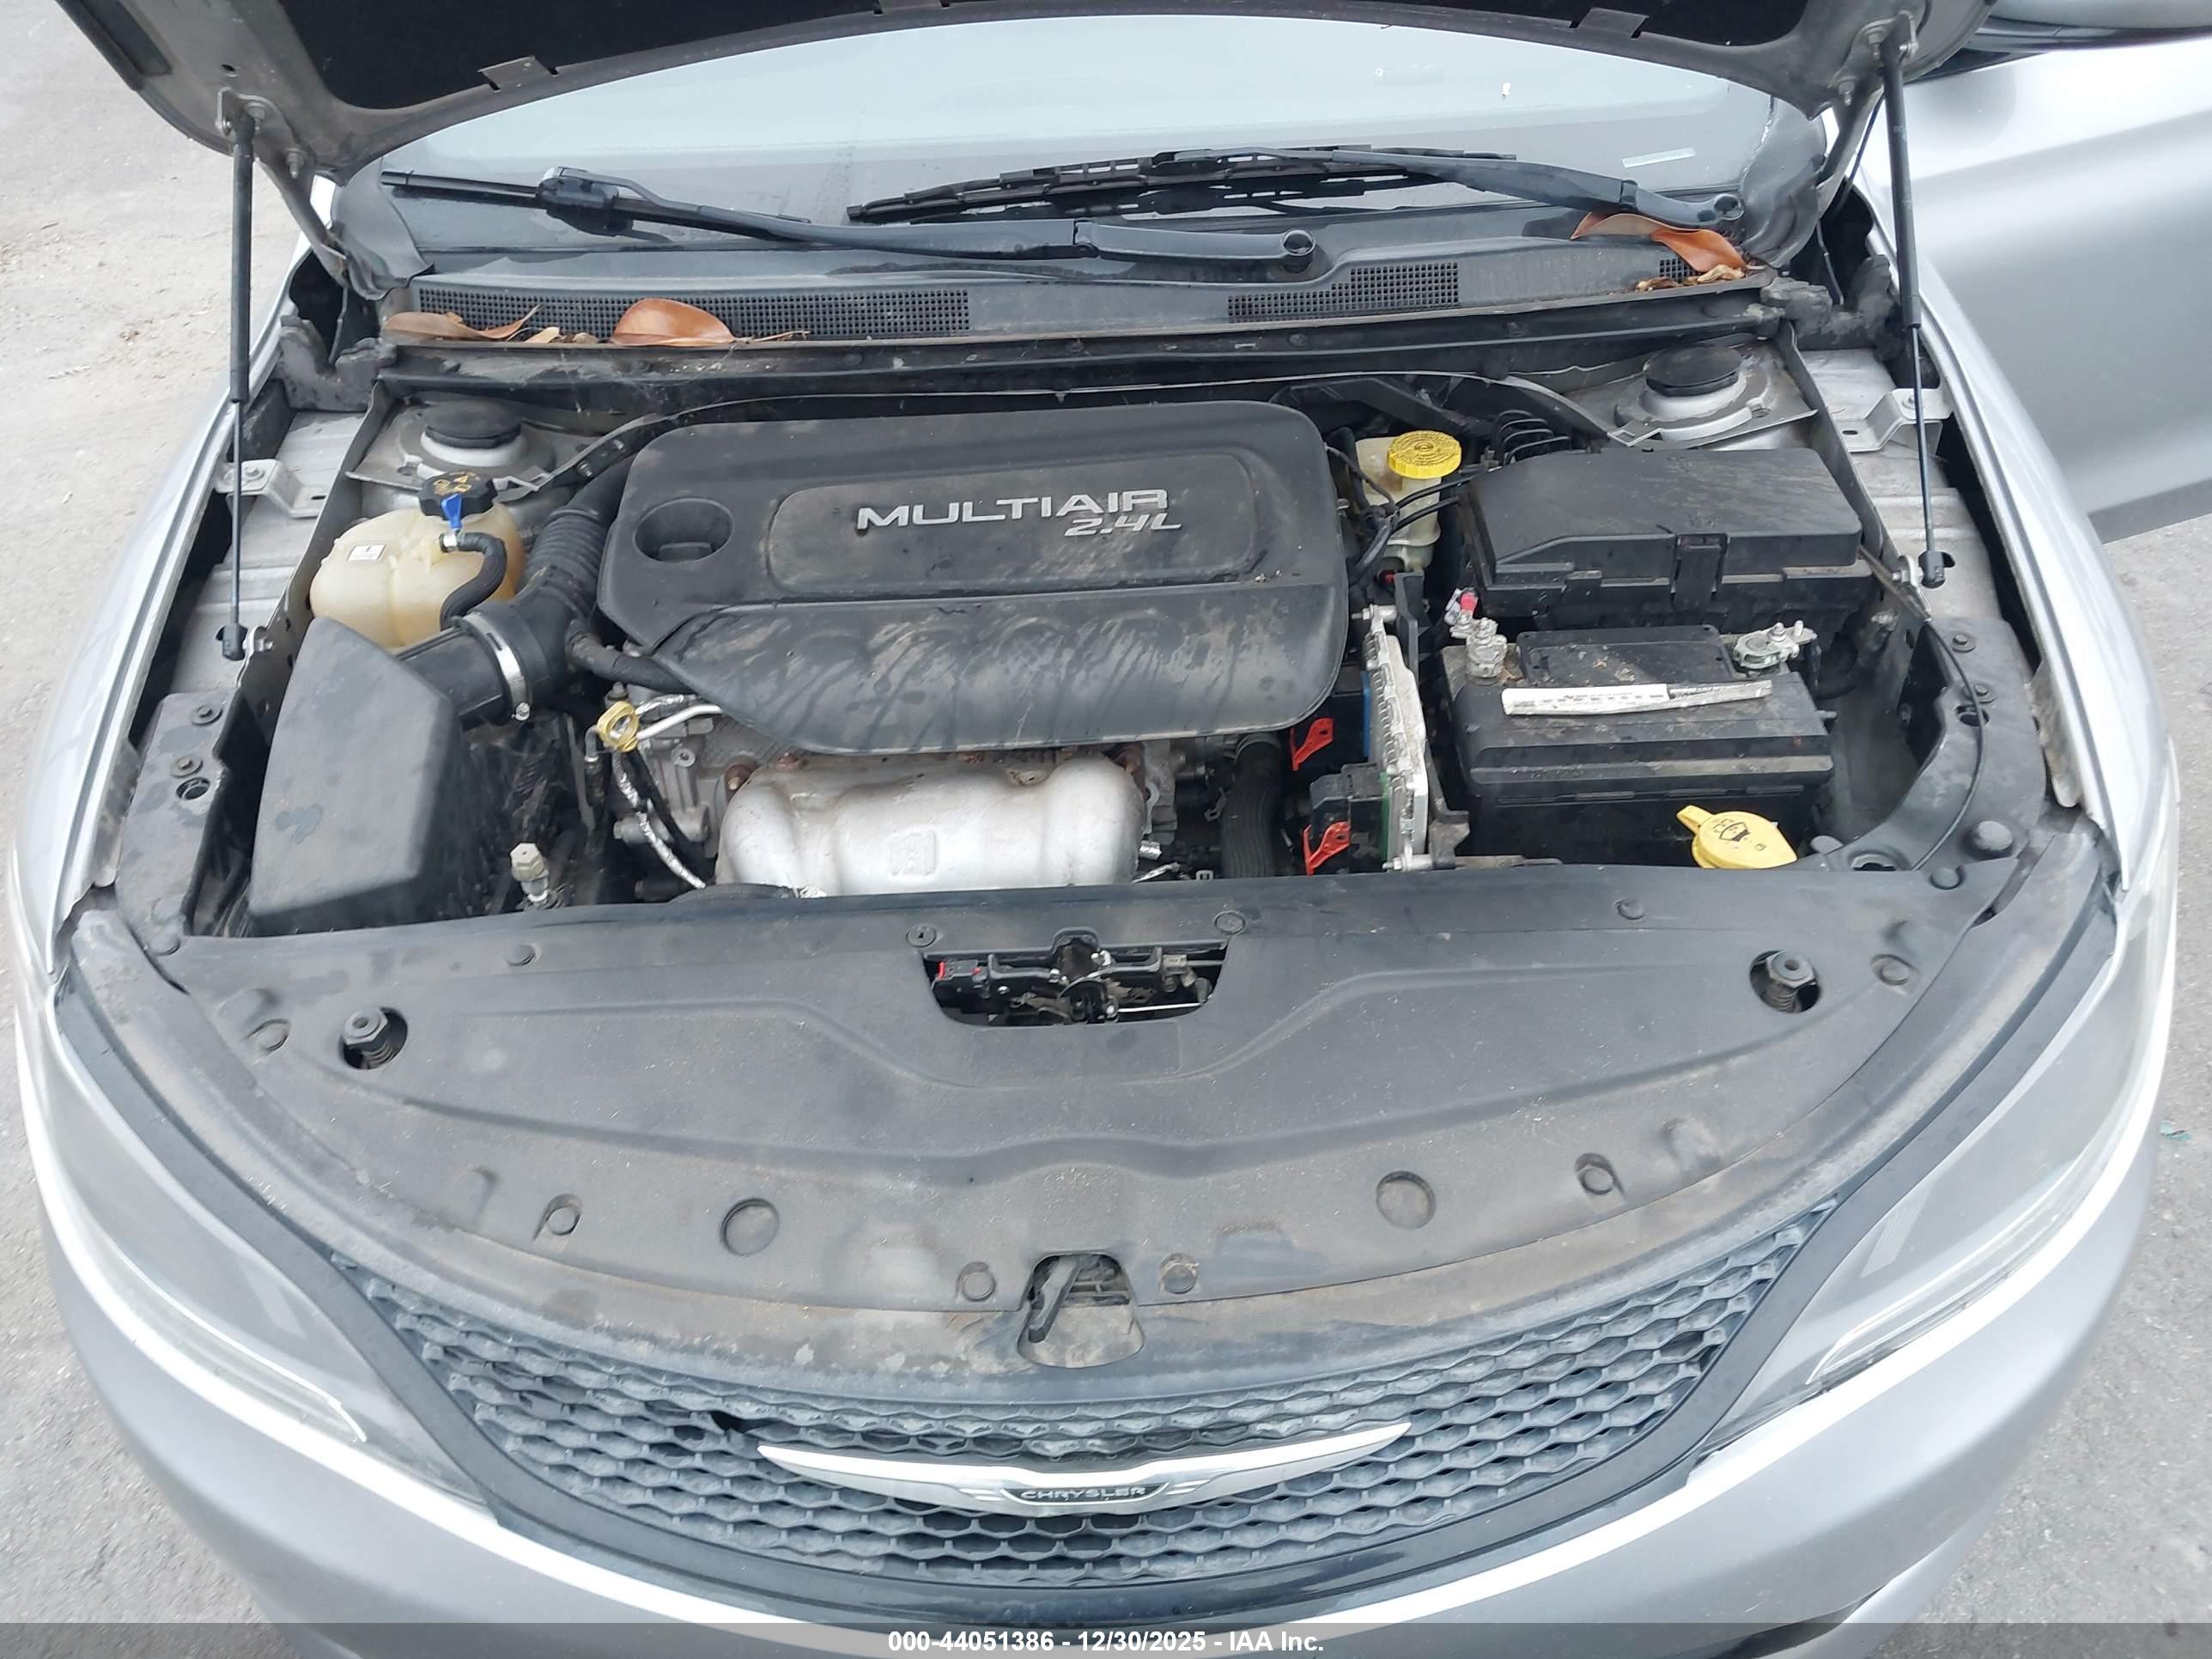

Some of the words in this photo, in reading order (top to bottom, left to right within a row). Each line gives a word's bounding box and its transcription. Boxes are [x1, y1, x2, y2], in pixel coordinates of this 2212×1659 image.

[857, 489, 1169, 530] MULTIAIR
[1064, 513, 1182, 537] 2.4L
[1021, 1486, 1146, 1499] CHRYSLER
